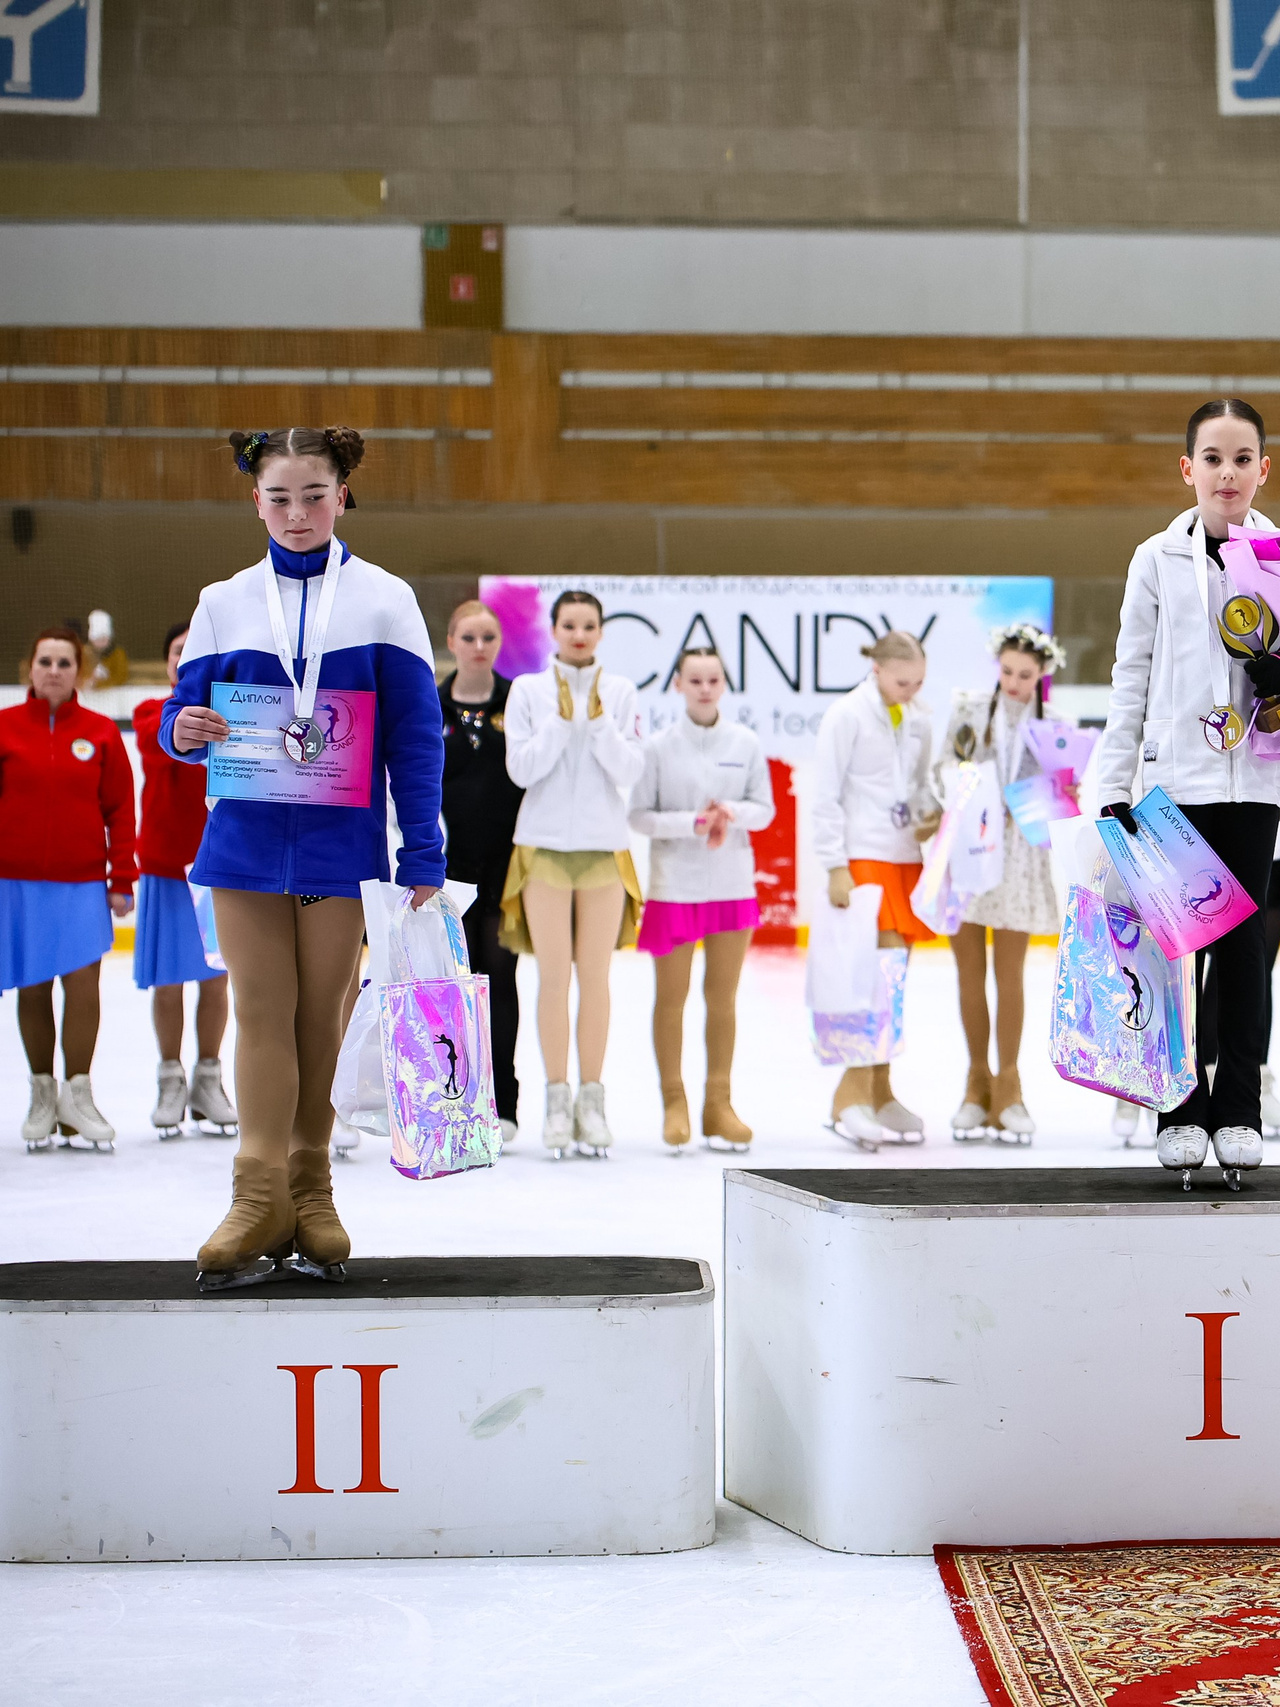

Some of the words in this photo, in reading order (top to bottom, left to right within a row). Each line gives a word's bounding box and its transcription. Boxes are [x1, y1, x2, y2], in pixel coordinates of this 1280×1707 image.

[631, 581, 719, 595] ДЕТСКОЙ
[723, 581, 738, 594] И
[740, 580, 899, 595] ПОДРОСТКОВОЙ
[903, 580, 992, 596] ОДЕЖДЫ
[331, 733, 357, 752] CANDY
[1137, 809, 1164, 843] Награждается
[1180, 882, 1190, 909] КУБОК
[1188, 909, 1214, 924] CANDY
[1186, 1312, 1240, 1441] I
[278, 1364, 400, 1494] II
